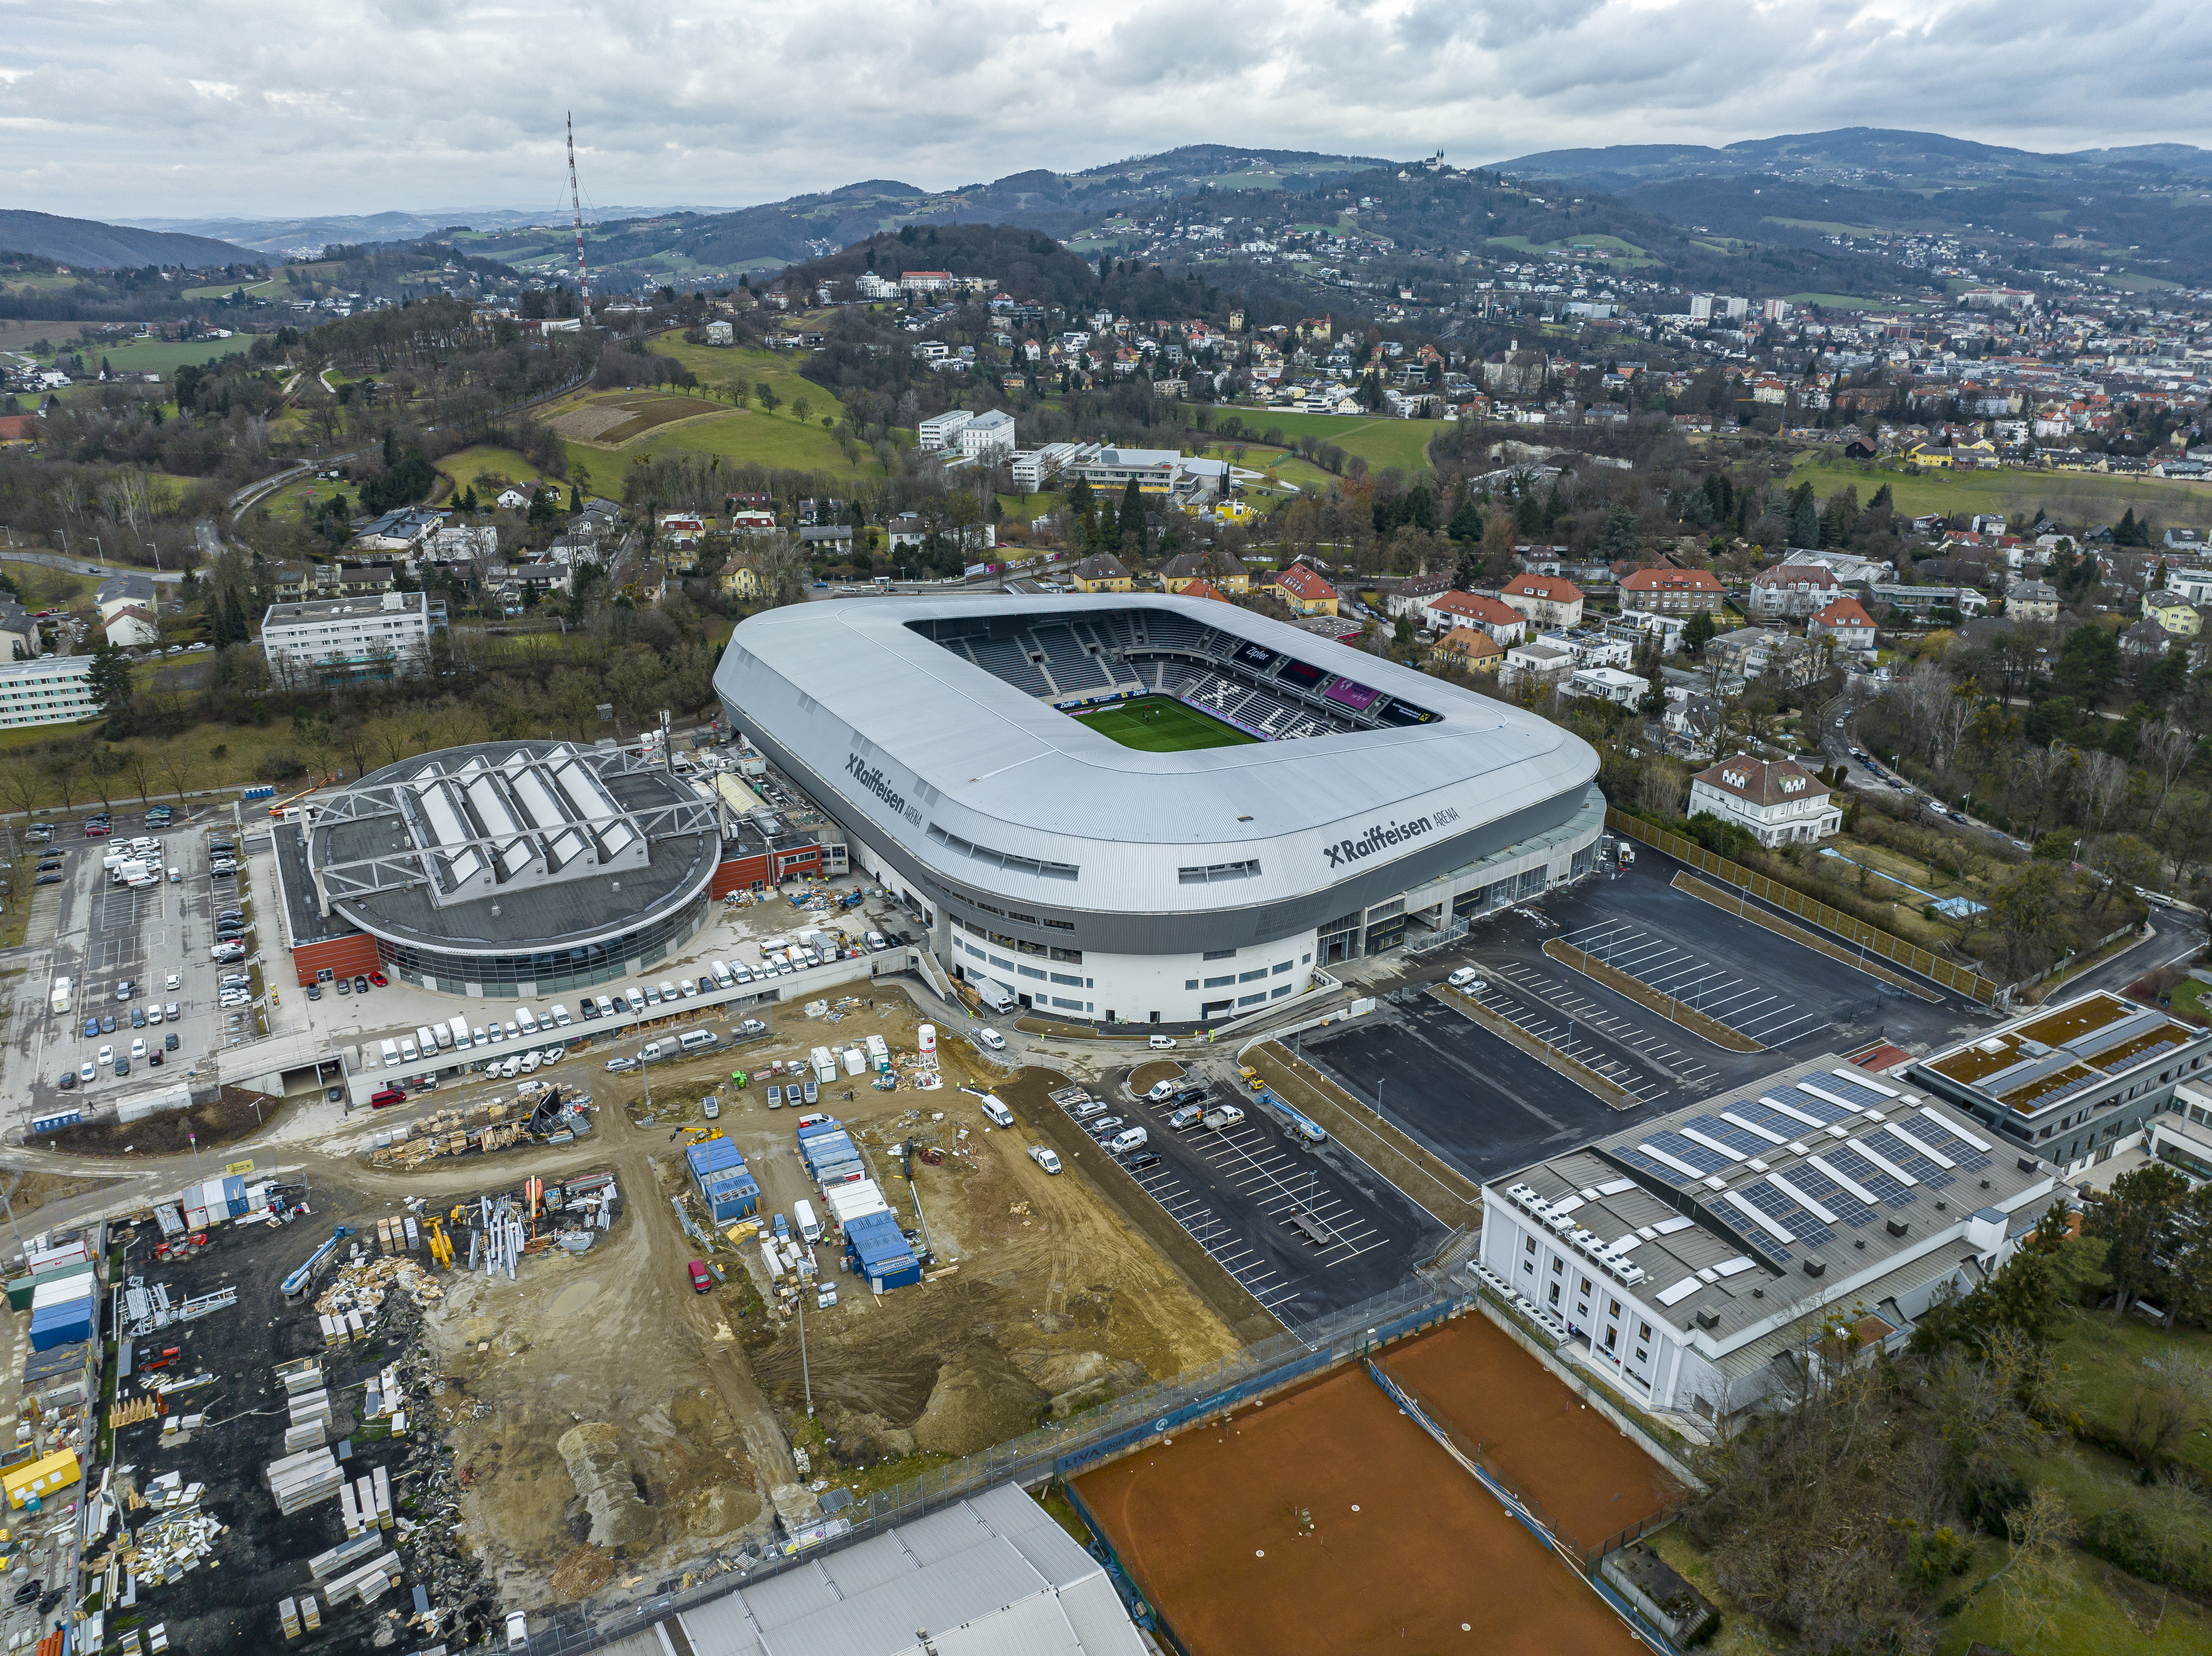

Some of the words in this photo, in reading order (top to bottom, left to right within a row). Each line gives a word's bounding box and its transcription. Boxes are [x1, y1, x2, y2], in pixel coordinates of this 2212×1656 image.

[1246, 646, 1269, 660] Zipfer
[1352, 683, 1374, 694] CHANGE
[1353, 688, 1369, 697] WORLD
[853, 758, 905, 814] Raiffeisen
[903, 805, 922, 828] ARENA
[1340, 817, 1433, 862] Raiffeisen
[1432, 807, 1461, 827] ARENA
[1065, 1448, 1100, 1468] LIVA
[1101, 1437, 1125, 1453] sport
